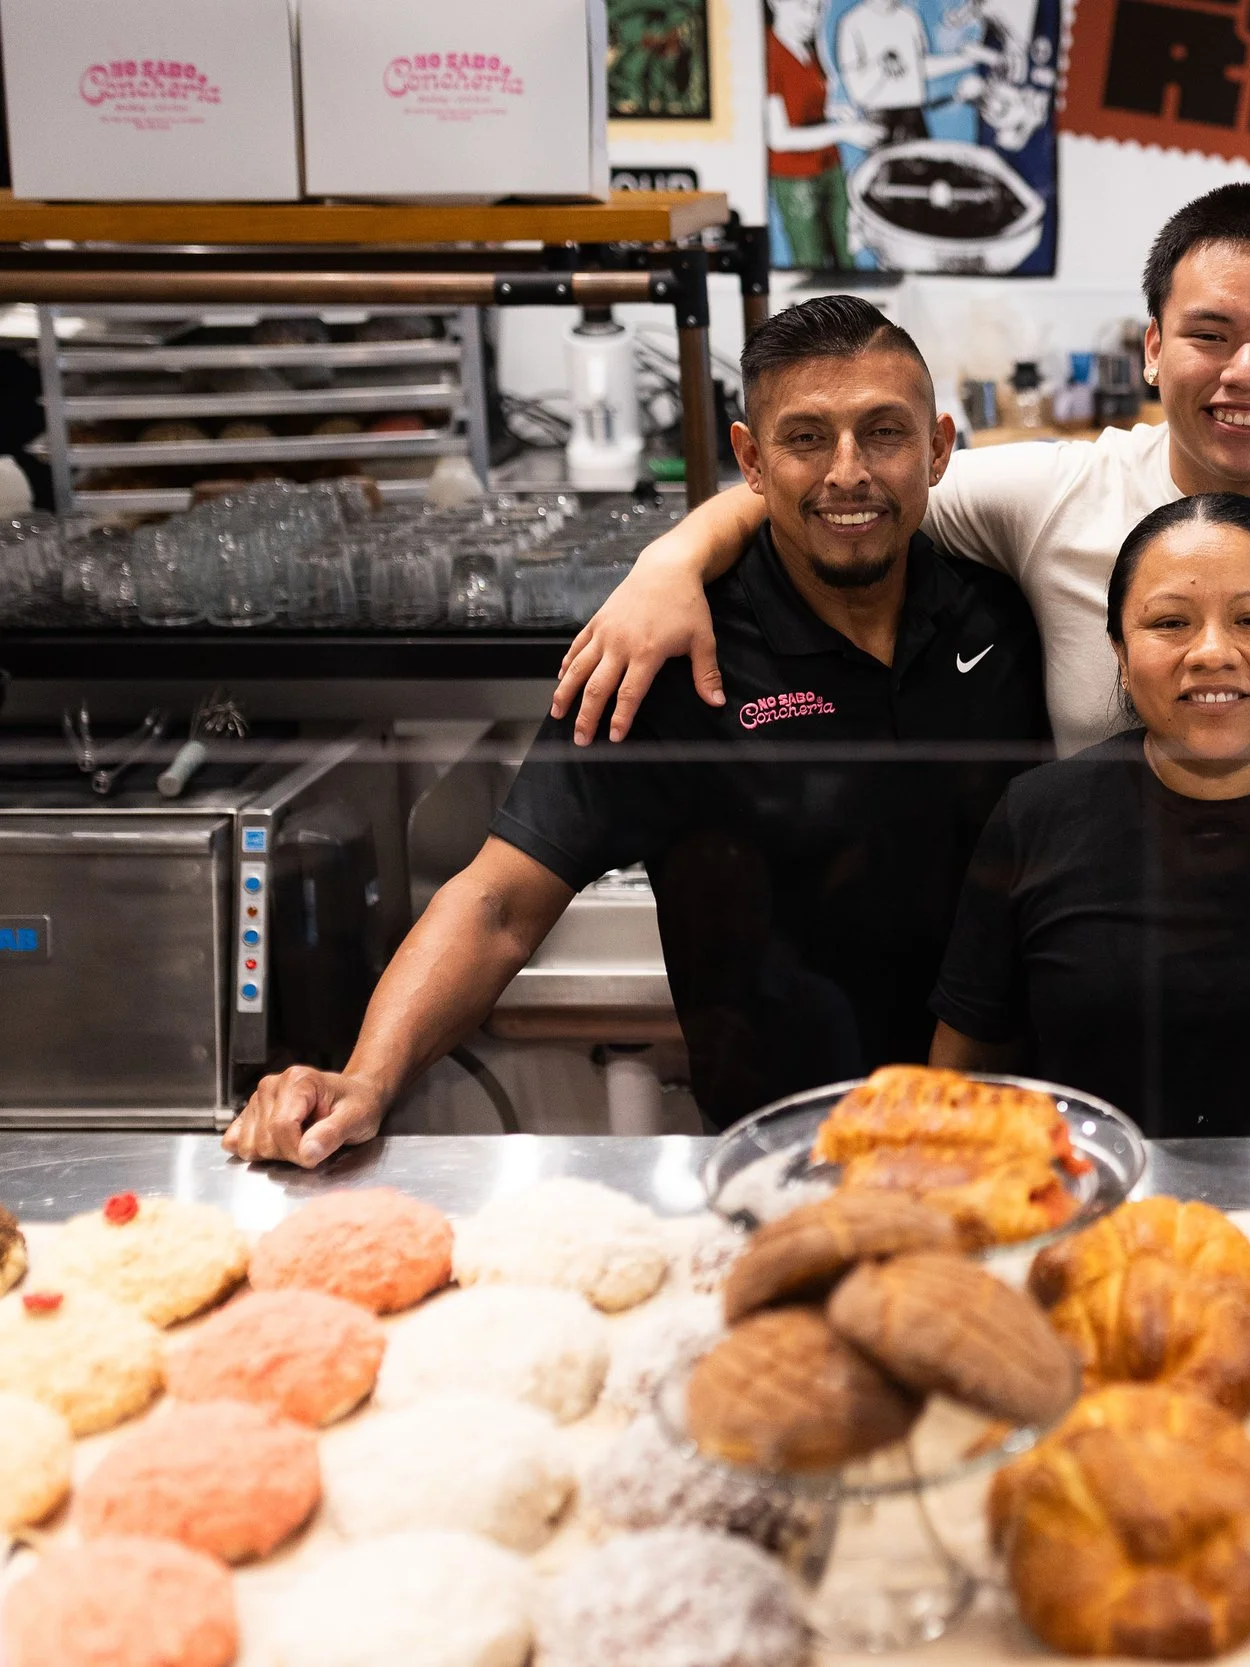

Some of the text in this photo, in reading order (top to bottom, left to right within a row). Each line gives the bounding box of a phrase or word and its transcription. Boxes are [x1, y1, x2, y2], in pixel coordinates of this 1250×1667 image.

[757, 691, 815, 711] NO SABO
[740, 699, 836, 730] Concheria
